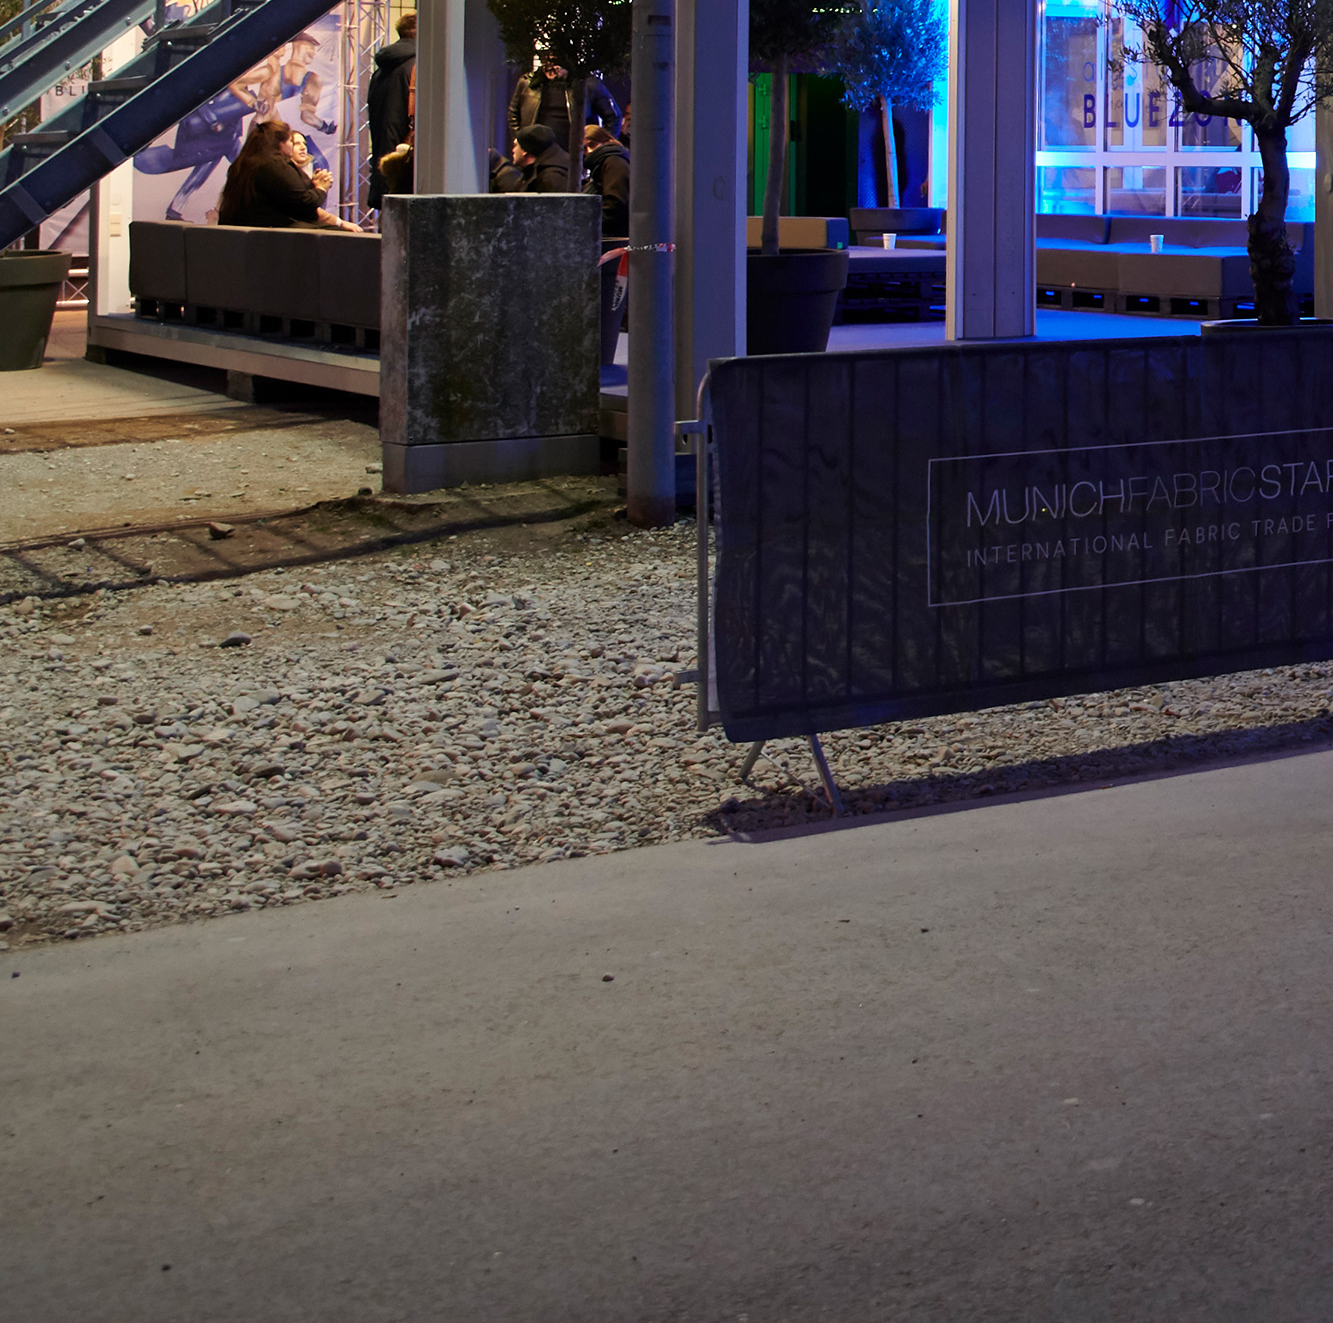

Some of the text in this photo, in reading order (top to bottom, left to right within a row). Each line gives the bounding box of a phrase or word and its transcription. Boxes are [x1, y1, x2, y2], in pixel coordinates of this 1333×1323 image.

[967, 531, 1154, 568] INTERNATIONAL
[1164, 522, 1242, 548] FABRIC
[1251, 515, 1315, 538] TRADE
